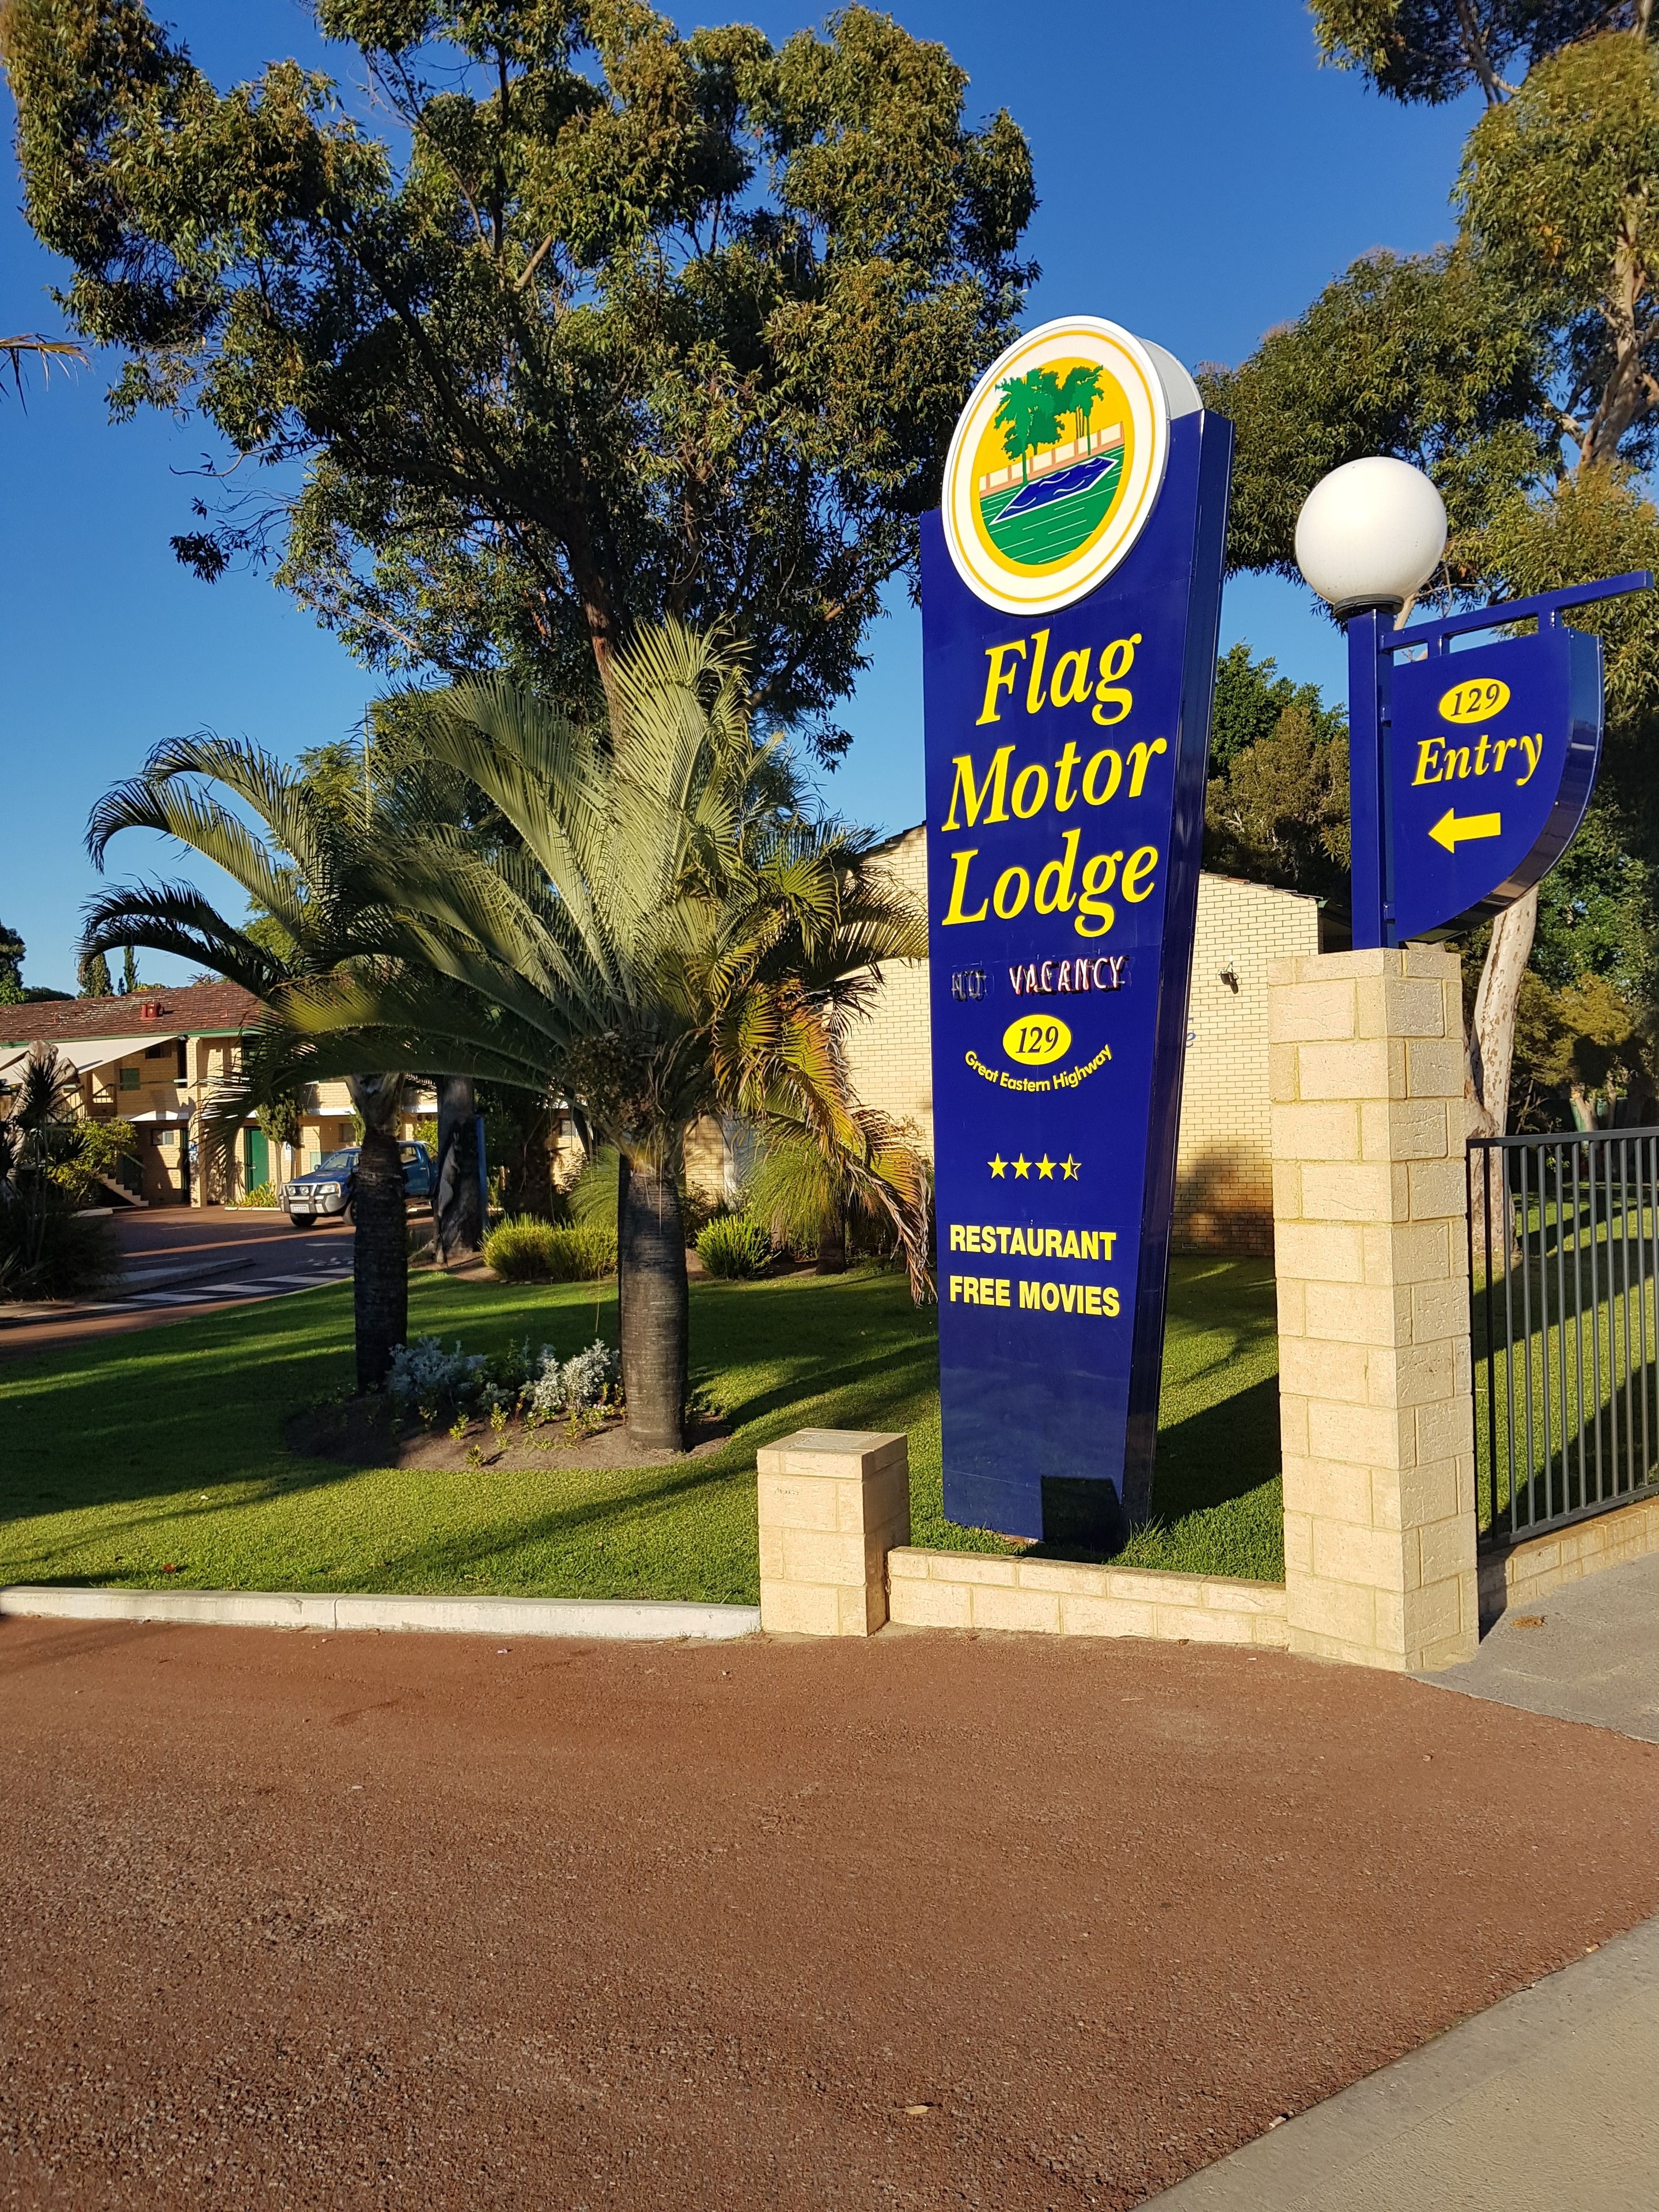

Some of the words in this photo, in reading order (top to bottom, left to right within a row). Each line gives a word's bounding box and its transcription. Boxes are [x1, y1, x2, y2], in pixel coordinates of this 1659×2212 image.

[975, 628, 1142, 726] Flag
[1450, 683, 1500, 717] 129
[1411, 733, 1543, 787] Entry
[941, 737, 1167, 831] Motor
[941, 828, 1158, 938] Lodge
[1009, 956, 1123, 995] VACANCY
[1015, 1025, 1059, 1054] 129
[965, 1051, 999, 1083] Great
[999, 1072, 1051, 1092] Eastern
[1052, 1044, 1112, 1089] Highway
[950, 1224, 1117, 1261] RESTAURANT
[949, 1275, 1010, 1308] FREE
[1019, 1281, 1120, 1317] MOVIES
